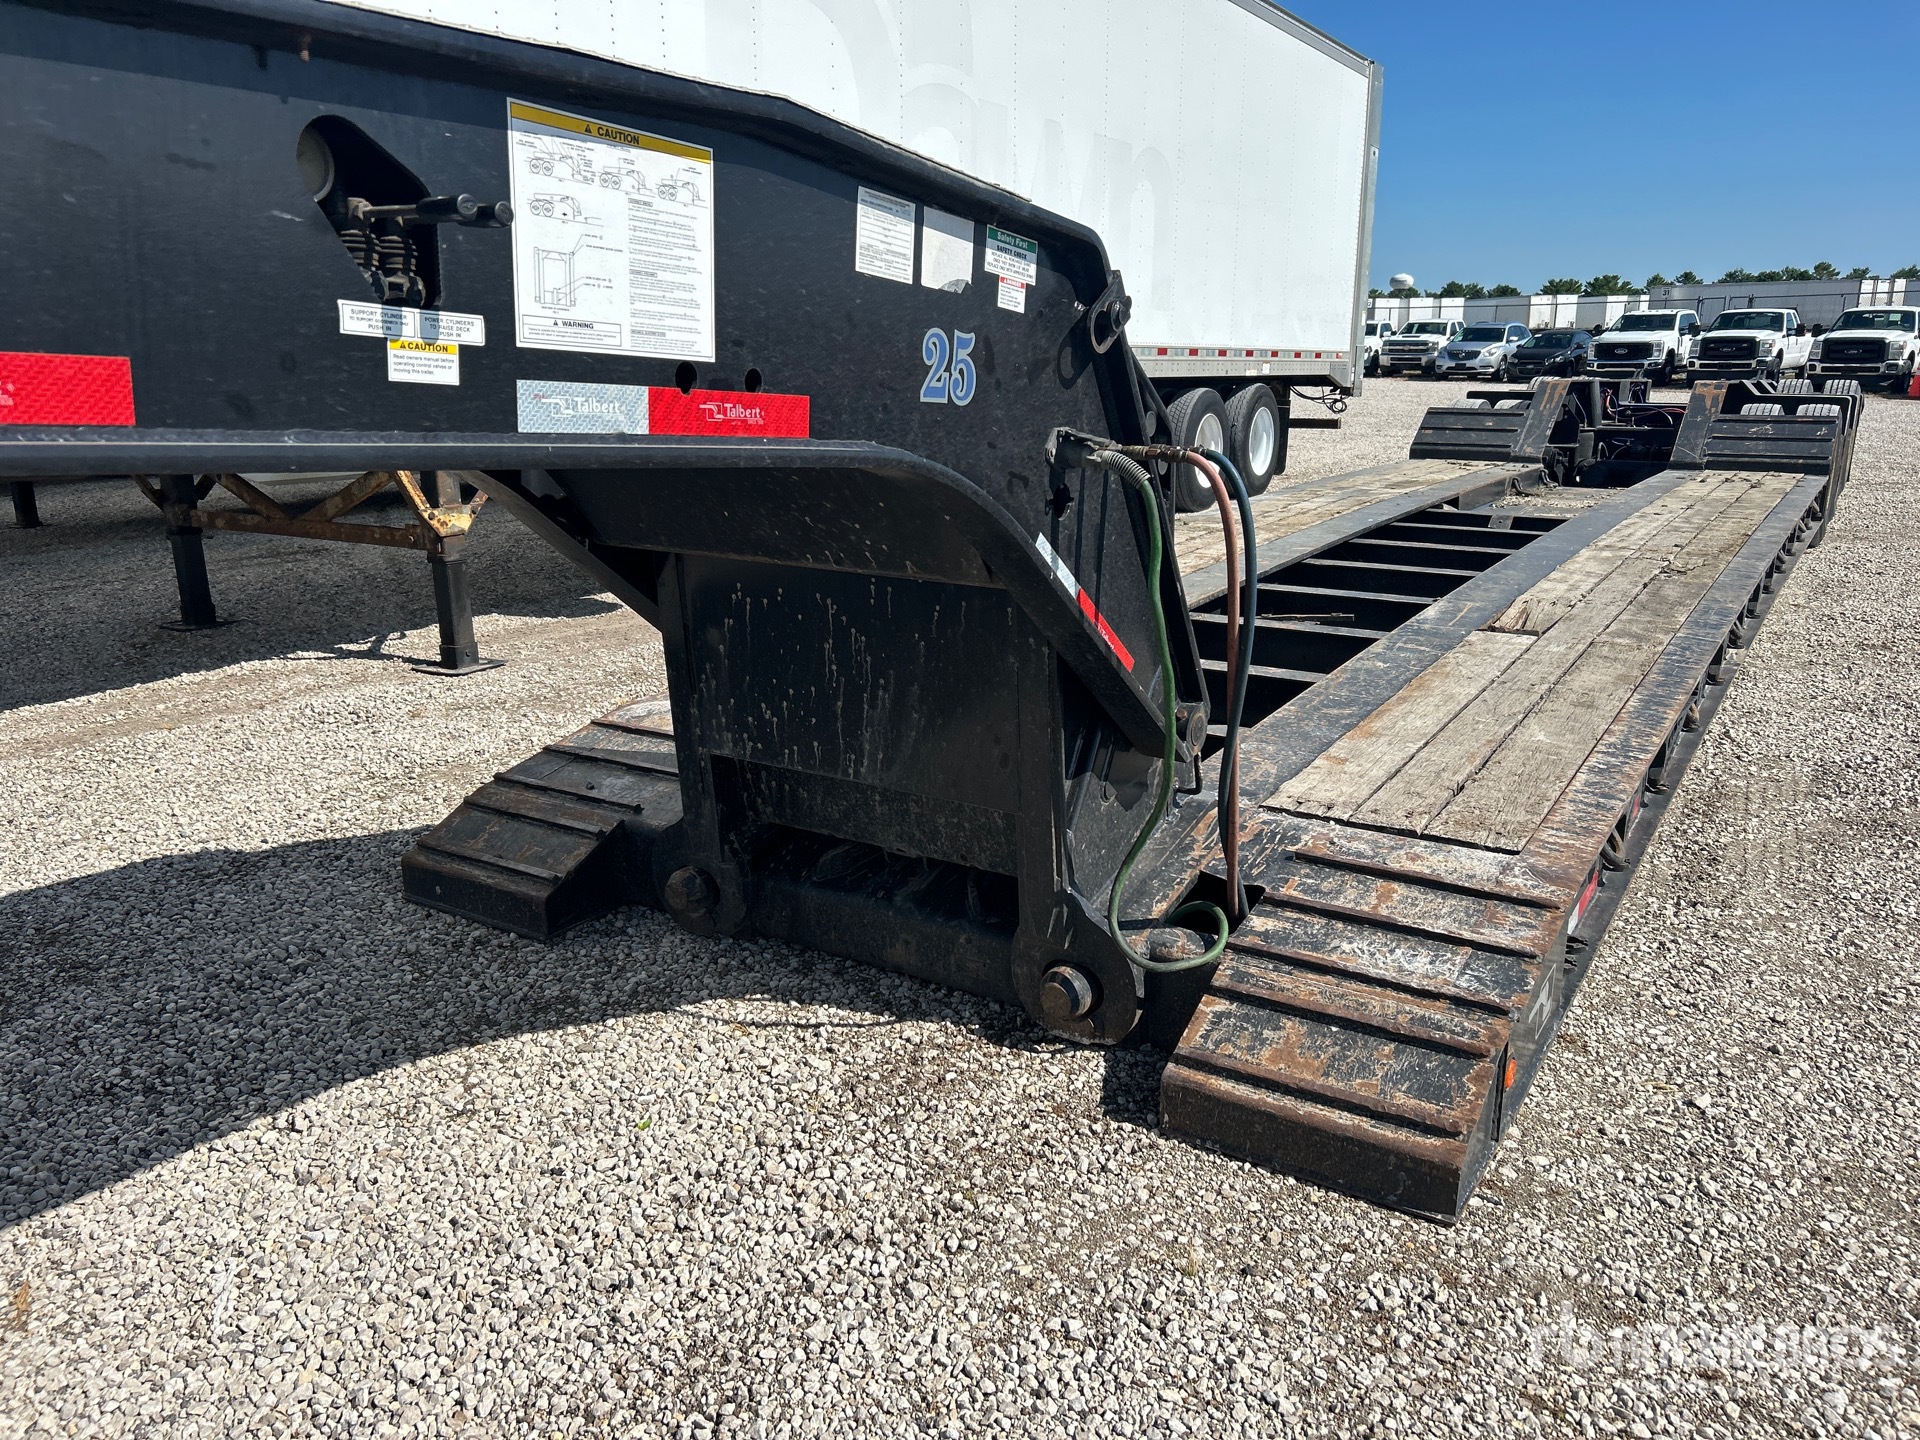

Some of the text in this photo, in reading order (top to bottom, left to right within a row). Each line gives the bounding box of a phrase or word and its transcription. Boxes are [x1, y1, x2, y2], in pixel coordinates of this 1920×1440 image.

[597, 126, 640, 145] CAUTION
[997, 232, 1028, 249] Safety First
[997, 245, 1027, 260] SAFETY CHECK
[351, 309, 377, 317] SUPPORT
[446, 318, 474, 326] CYLINDERS
[562, 320, 594, 329] WARNING
[408, 342, 448, 352] CAUTION
[920, 328, 976, 406] 25
[574, 397, 620, 414] Talbert
[724, 404, 760, 418] Talbert
